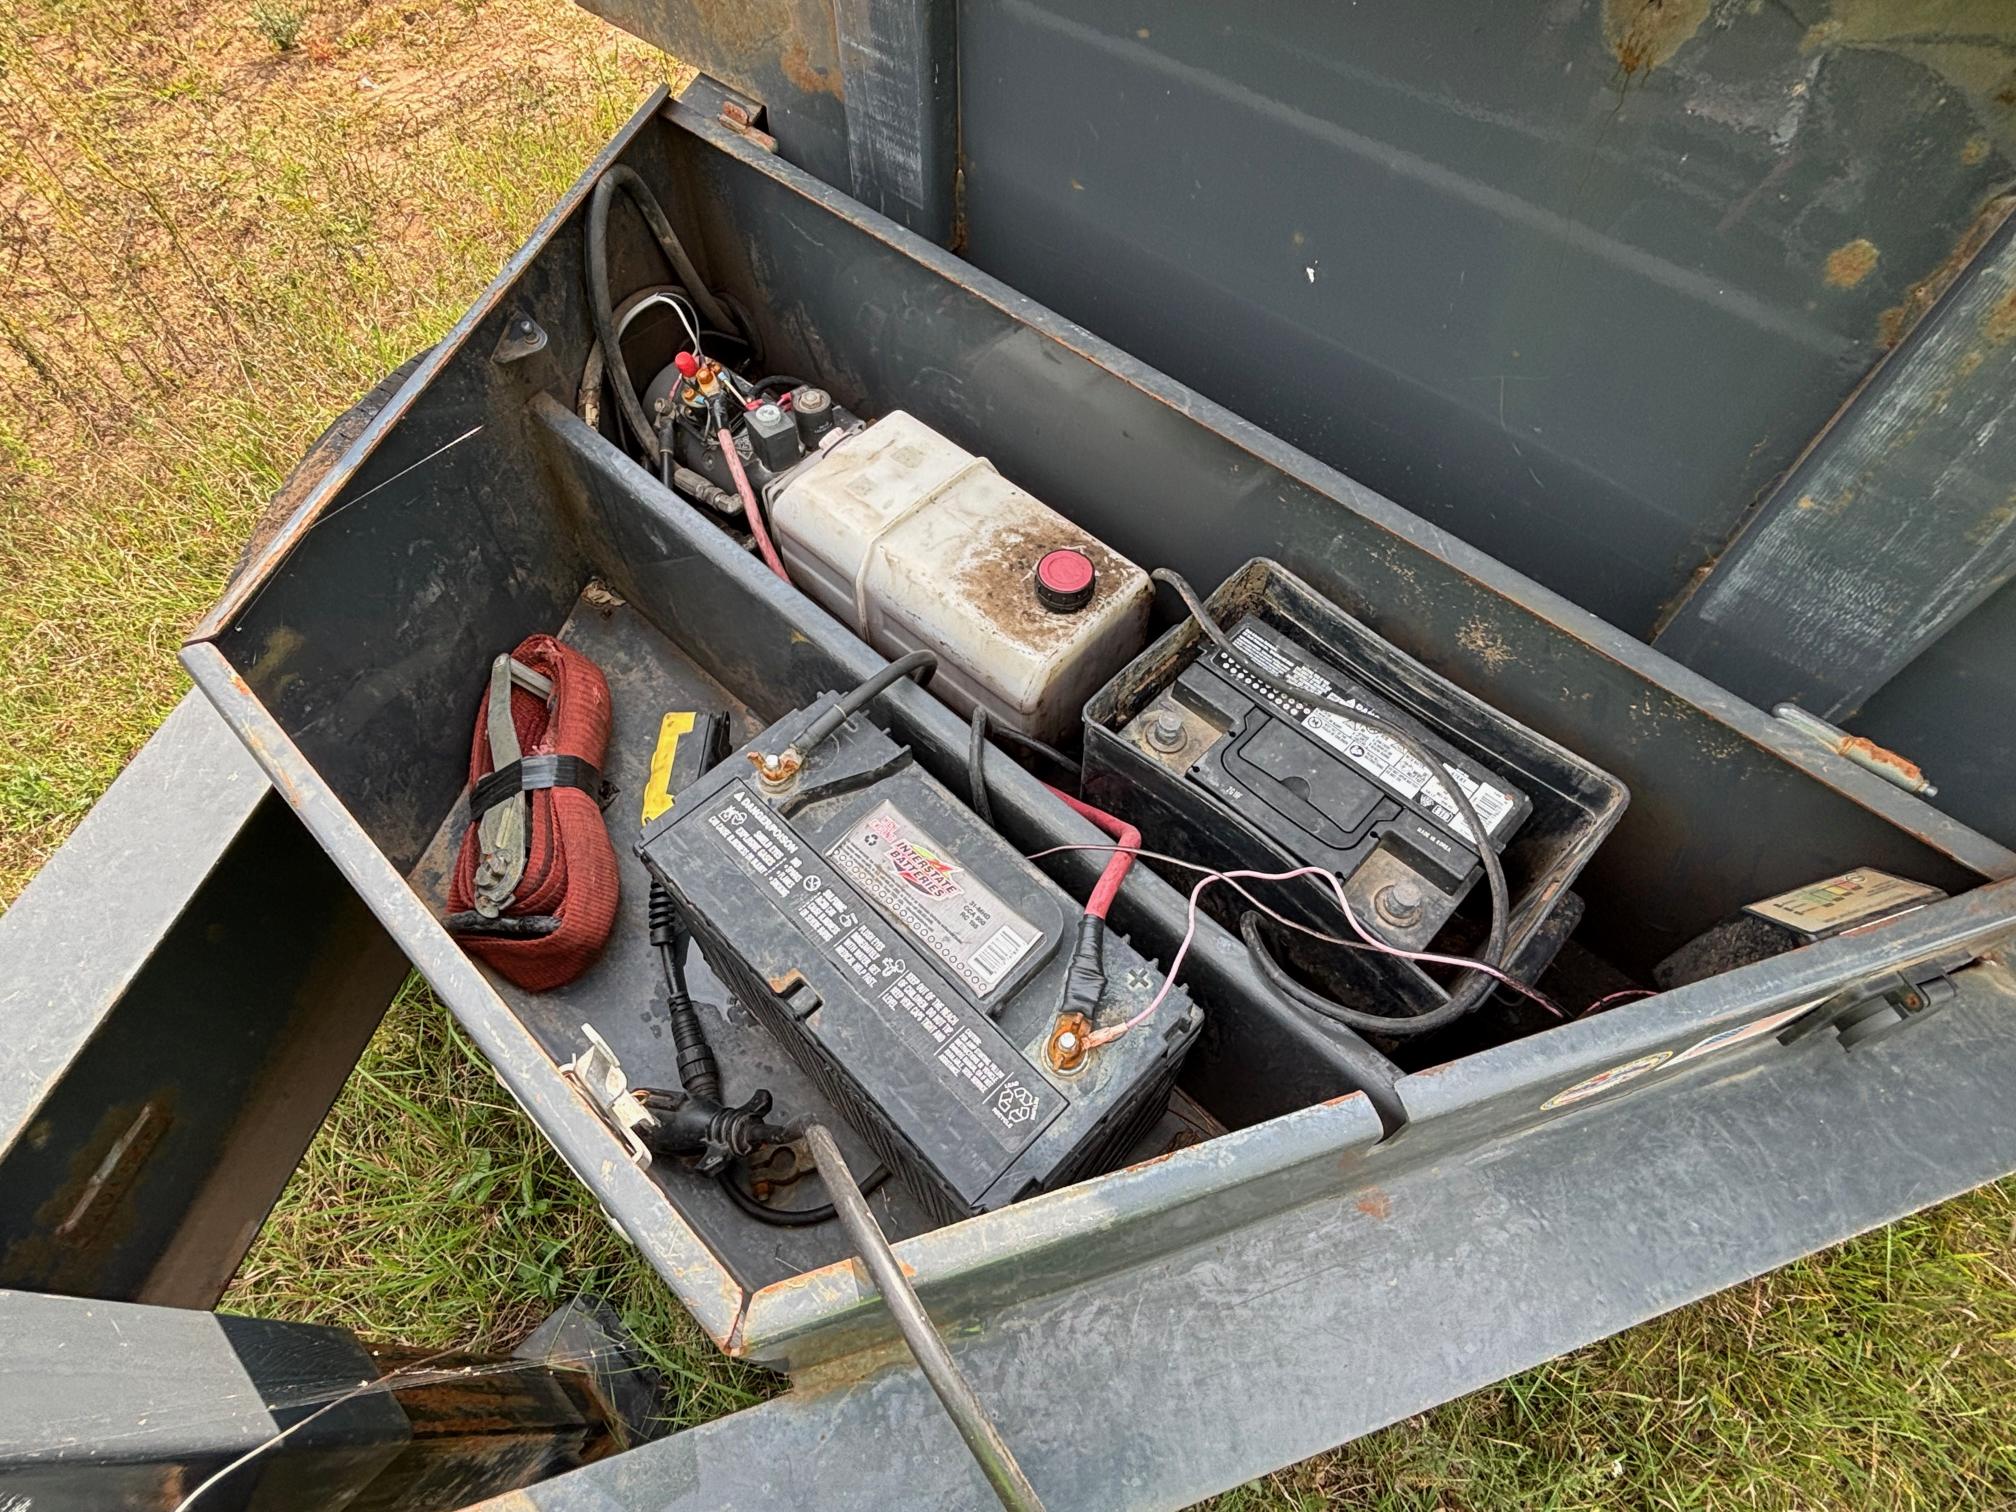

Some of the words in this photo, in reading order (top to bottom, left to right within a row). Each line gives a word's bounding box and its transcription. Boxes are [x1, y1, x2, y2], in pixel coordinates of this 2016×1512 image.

[714, 822, 732, 838] CAUSE
[725, 833, 750, 857] BLINDNESS
[734, 825, 762, 852] EXPLOSIVE
[756, 848, 776, 867] GASES
[739, 796, 799, 854] DANGER/POISON
[752, 829, 773, 849] SHIELD
[767, 844, 785, 860] EYES
[889, 850, 945, 897] BATTERIES
[894, 841, 958, 894] INTERSTATE
[962, 904, 977, 918] CCA
[857, 923, 876, 942] FLUSH
[870, 936, 886, 952] EYES
[834, 943, 856, 966] MEDICAL
[851, 961, 867, 976] HELP
[889, 985, 905, 1000] KEEP
[898, 995, 915, 1011] VENT
[908, 1005, 925, 1022] CAPS
[931, 1029, 946, 1043] AND
[896, 977, 909, 989] OF
[925, 1006, 937, 1019] DO
[931, 1013, 946, 1027] NOT
[904, 970, 921, 986] KEEP
[914, 981, 930, 996] OUT
[923, 990, 936, 1002] OF
[930, 997, 945, 1012] THE
[939, 1006, 959, 1026] REACH
[991, 1106, 1013, 1129] RECYCLE
